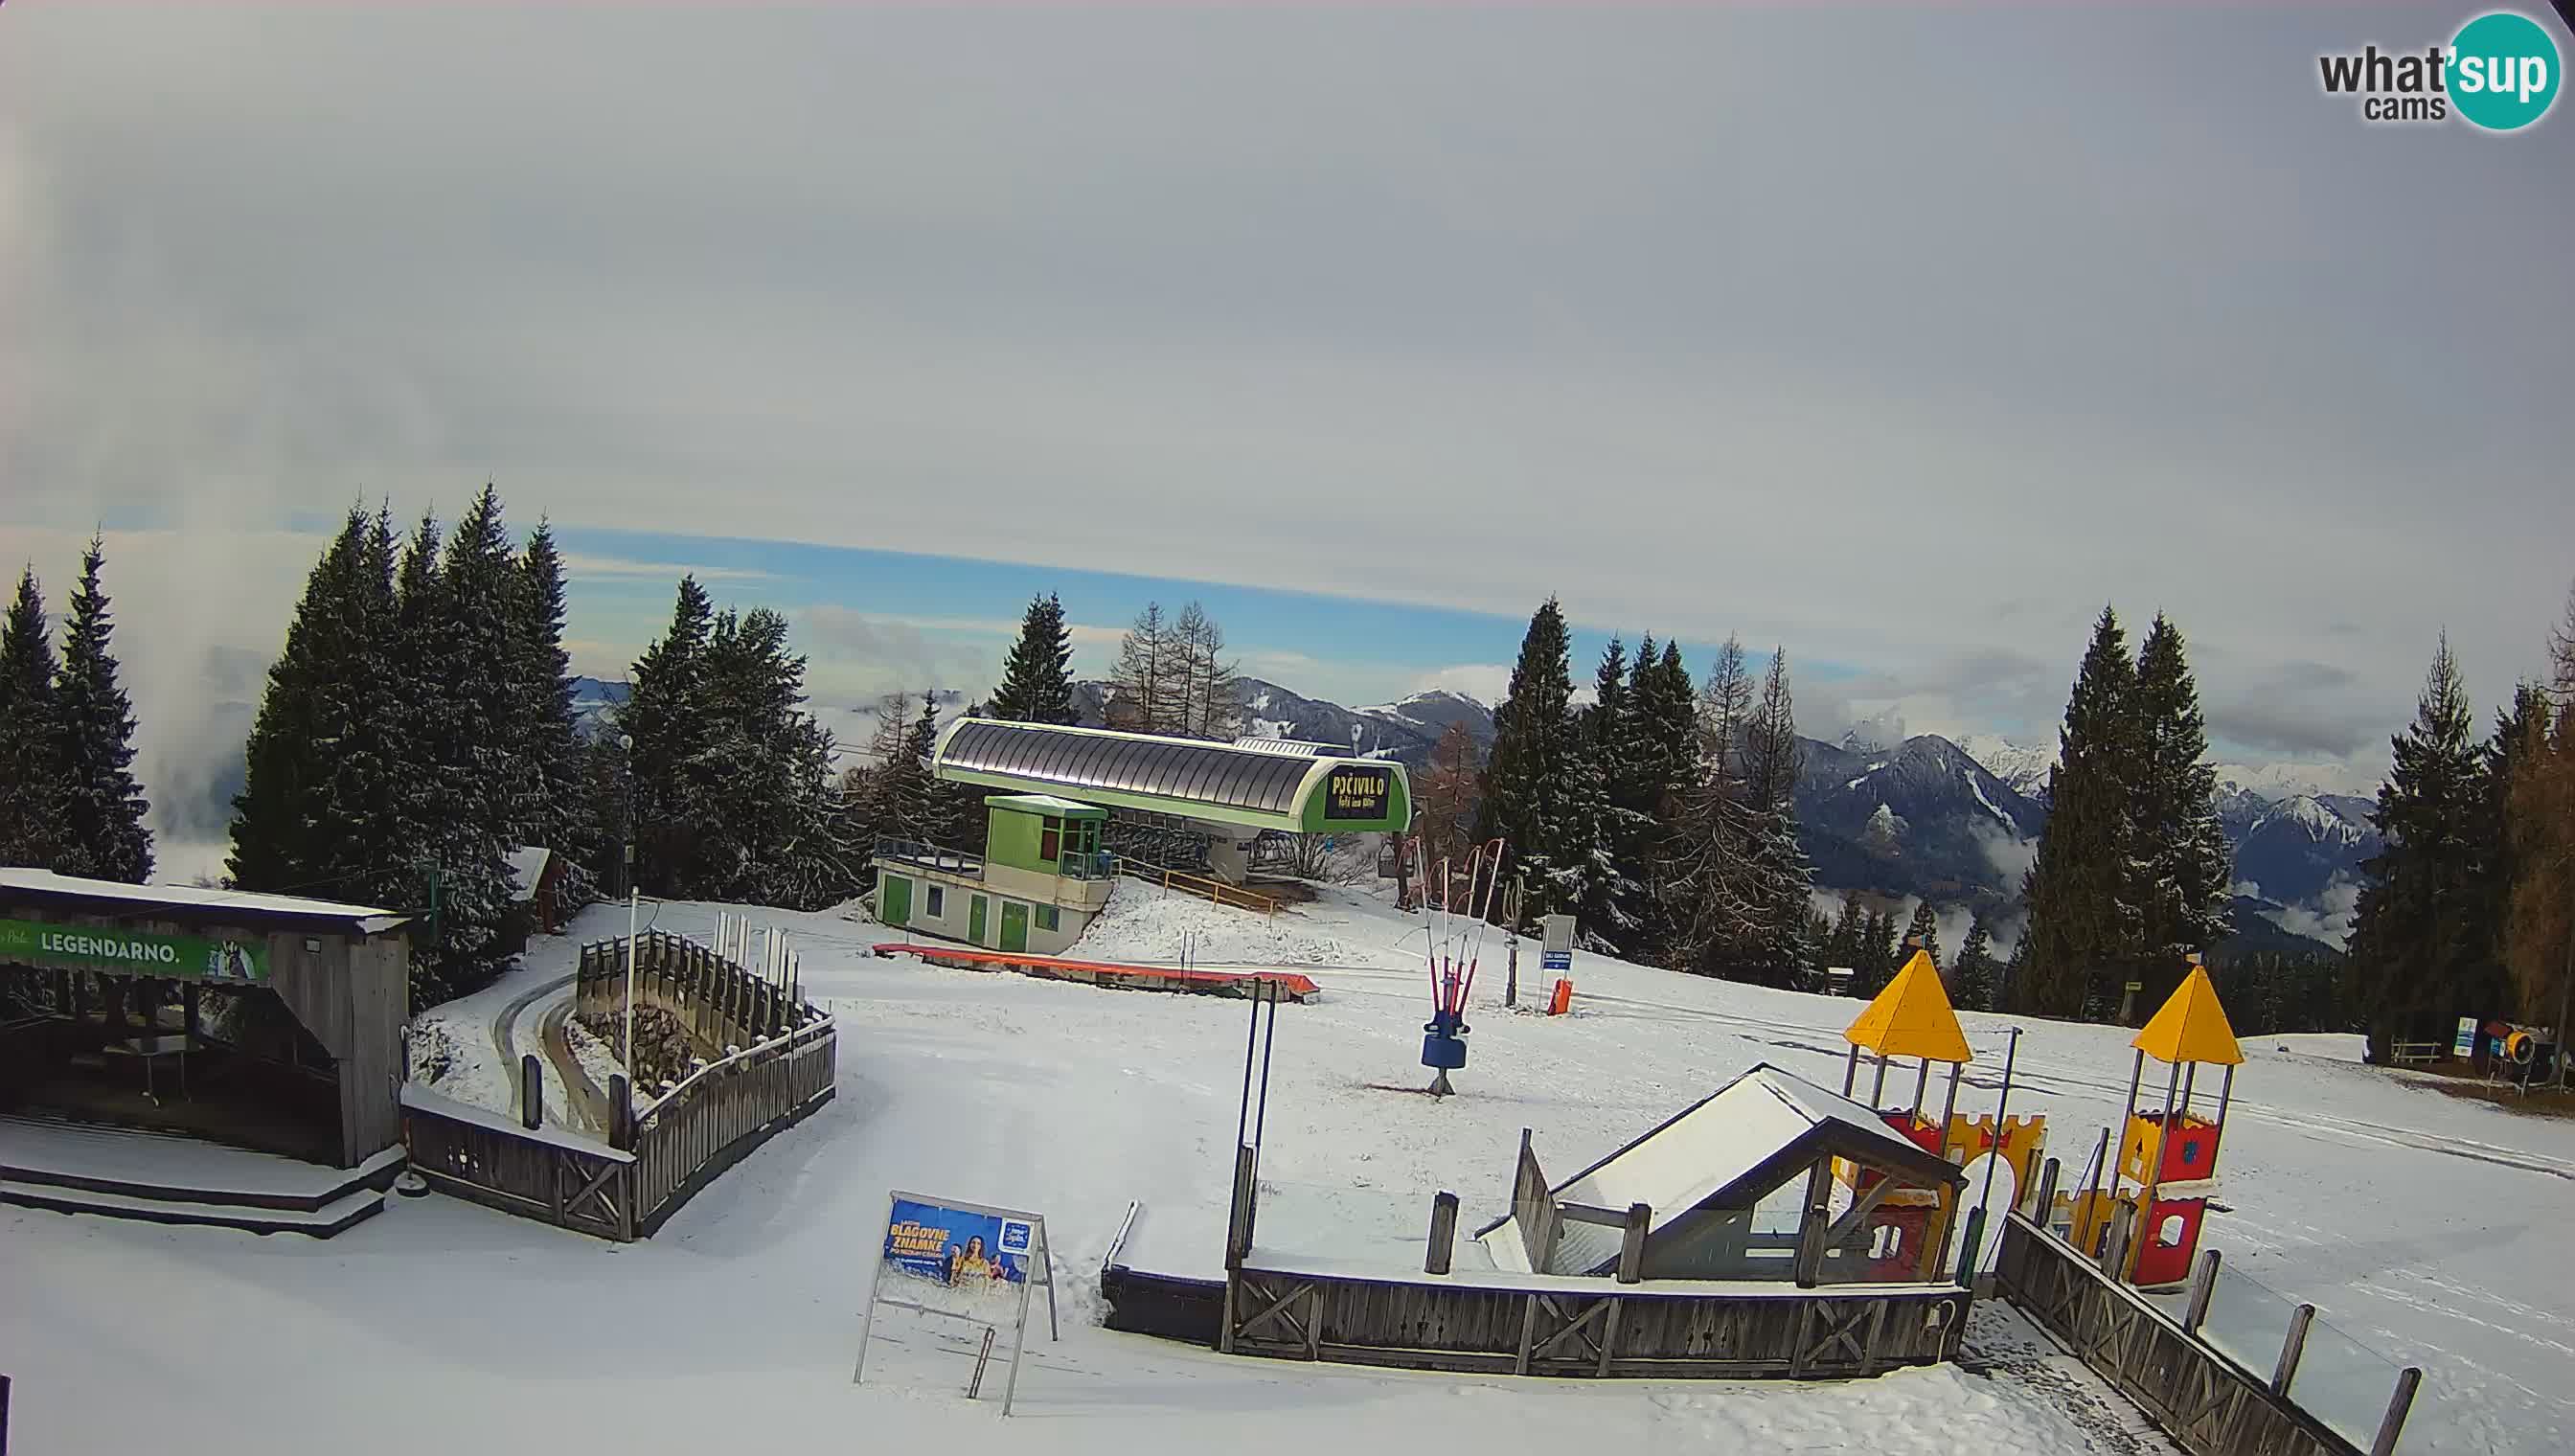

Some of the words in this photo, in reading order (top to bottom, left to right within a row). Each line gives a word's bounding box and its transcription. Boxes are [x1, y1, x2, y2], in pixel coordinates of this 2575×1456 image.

[40, 932, 180, 964] LEGENDARNO.
[890, 1224, 951, 1241] BLAGOVNE
[893, 1236, 944, 1252] ZNAMKE
